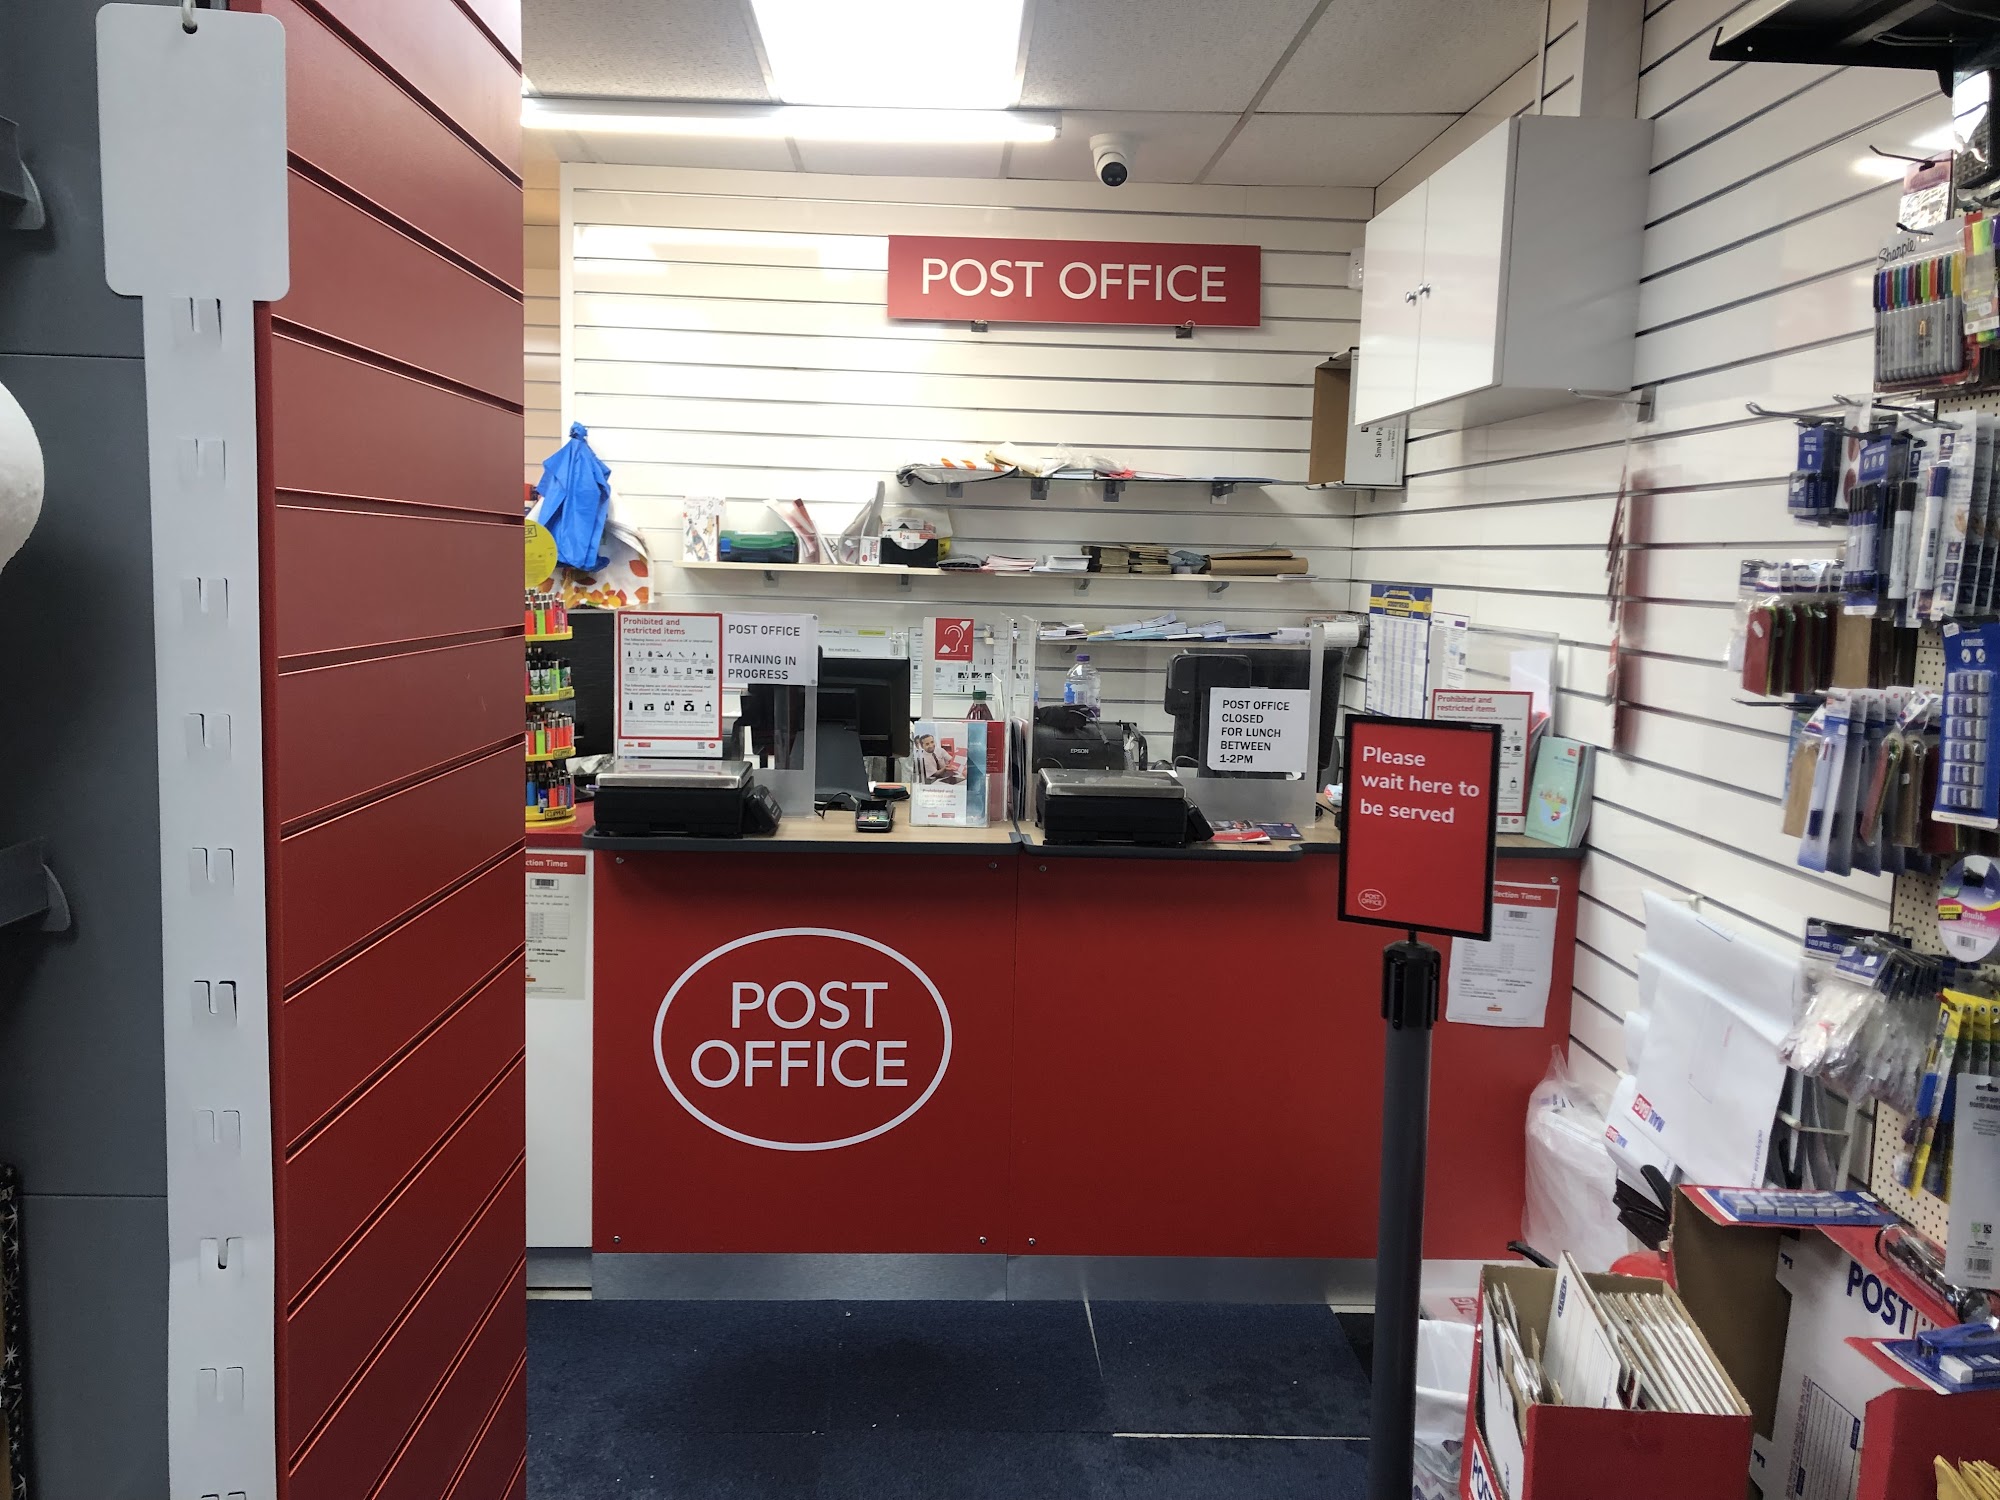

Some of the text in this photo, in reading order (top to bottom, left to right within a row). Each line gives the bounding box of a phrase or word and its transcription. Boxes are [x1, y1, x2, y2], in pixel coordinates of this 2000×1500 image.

[1878, 237, 1916, 271] Sharpie
[921, 257, 1227, 303] POST OFFICE
[1374, 438, 1382, 458] Small
[624, 617, 664, 625] Prohibited
[728, 624, 800, 636] POST OFFICE
[964, 644, 969, 653] T
[728, 654, 796, 666] TRAINING IN
[728, 668, 788, 680] PROGRESS
[1438, 694, 1476, 703] Prohibited
[1222, 700, 1290, 710] POST OFFICE
[1222, 714, 1264, 723] CLOSED
[1222, 727, 1281, 738] FOR LUNCH
[1220, 741, 1271, 751] BETWEEN
[1220, 754, 1253, 764] 1-2PM
[1362, 746, 1426, 767] Please
[1361, 772, 1480, 798] wait here to
[1360, 798, 1455, 824] be served
[1361, 898, 1382, 906] OFFICE
[1521, 892, 1542, 901] Times
[731, 980, 889, 1029] POST
[690, 1039, 908, 1088] OFFICE
[1846, 1260, 1913, 1335] POST
